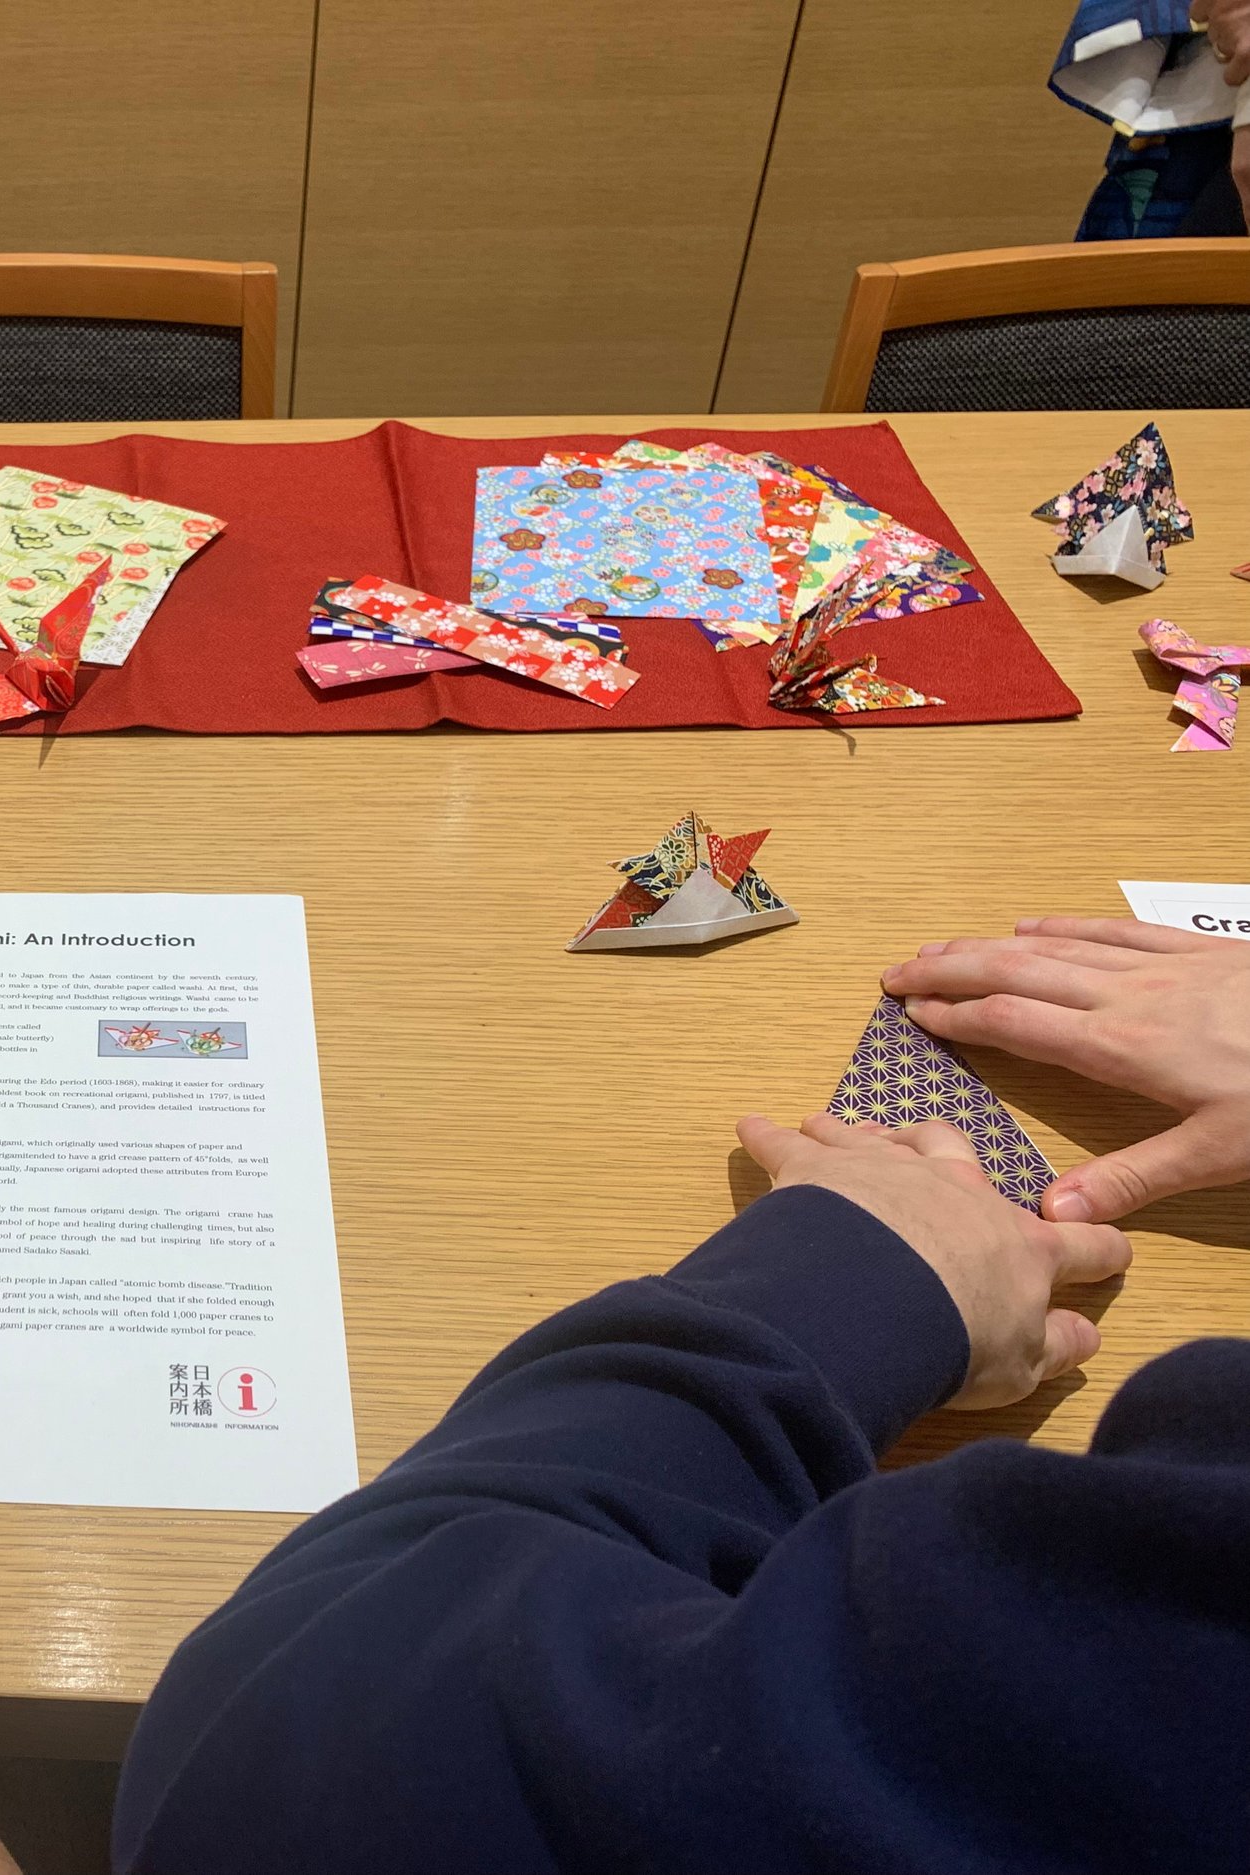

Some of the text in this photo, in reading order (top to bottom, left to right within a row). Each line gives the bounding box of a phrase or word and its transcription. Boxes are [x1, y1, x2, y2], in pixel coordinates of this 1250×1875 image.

[23, 932, 54, 946] An
[61, 932, 195, 947] Introduction
[15, 1034, 55, 1042] butterfly)
[39, 1077, 58, 1085] Edo
[58, 1078, 87, 1086] period
[88, 1078, 140, 1087] (1603-1868),
[141, 1079, 174, 1088] making
[210, 1080, 224, 1088] for
[227, 1081, 265, 1089] ordinary
[26, 1139, 53, 1147] which
[54, 1139, 96, 1148] originally
[97, 1140, 119, 1148] used
[153, 1141, 186, 1150] shapes
[197, 1143, 224, 1151] paper
[9, 1204, 24, 1212] the
[53, 1206, 87, 1214] famous
[89, 1207, 125, 1216] origami
[127, 1207, 160, 1216] design.
[162, 1207, 184, 1216] The
[184, 1209, 220, 1218] origami
[256, 1210, 274, 1219] has
[22, 1218, 36, 1226] of
[36, 1218, 60, 1228] hope
[62, 1219, 80, 1228] and
[82, 1220, 117, 1230] healing
[117, 1220, 149, 1231] during
[149, 1221, 203, 1232] challenging
[206, 1223, 236, 1233] times,
[236, 1224, 254, 1232] but
[254, 1224, 275, 1233] also
[22, 1246, 58, 1254] Sadako
[59, 1247, 91, 1255] Sasaki.
[14, 1276, 46, 1285] people
[58, 1276, 87, 1286] Japan
[88, 1277, 118, 1286] called
[119, 1279, 157, 1288] “atomic
[158, 1279, 186, 1288] bomb
[37, 1306, 60, 1316] sick,
[61, 1307, 99, 1316] schools
[100, 1307, 121, 1317] will
[122, 1308, 149, 1318] often
[150, 1309, 170, 1318] fold
[172, 1310, 198, 1319] 1,000
[198, 1312, 228, 1321] paper
[228, 1313, 262, 1321] cranes
[168, 1363, 190, 1416] 案内所
[192, 1364, 213, 1417] 日本橋
[170, 1421, 279, 1431] NIHONBASHI INFORMATION
